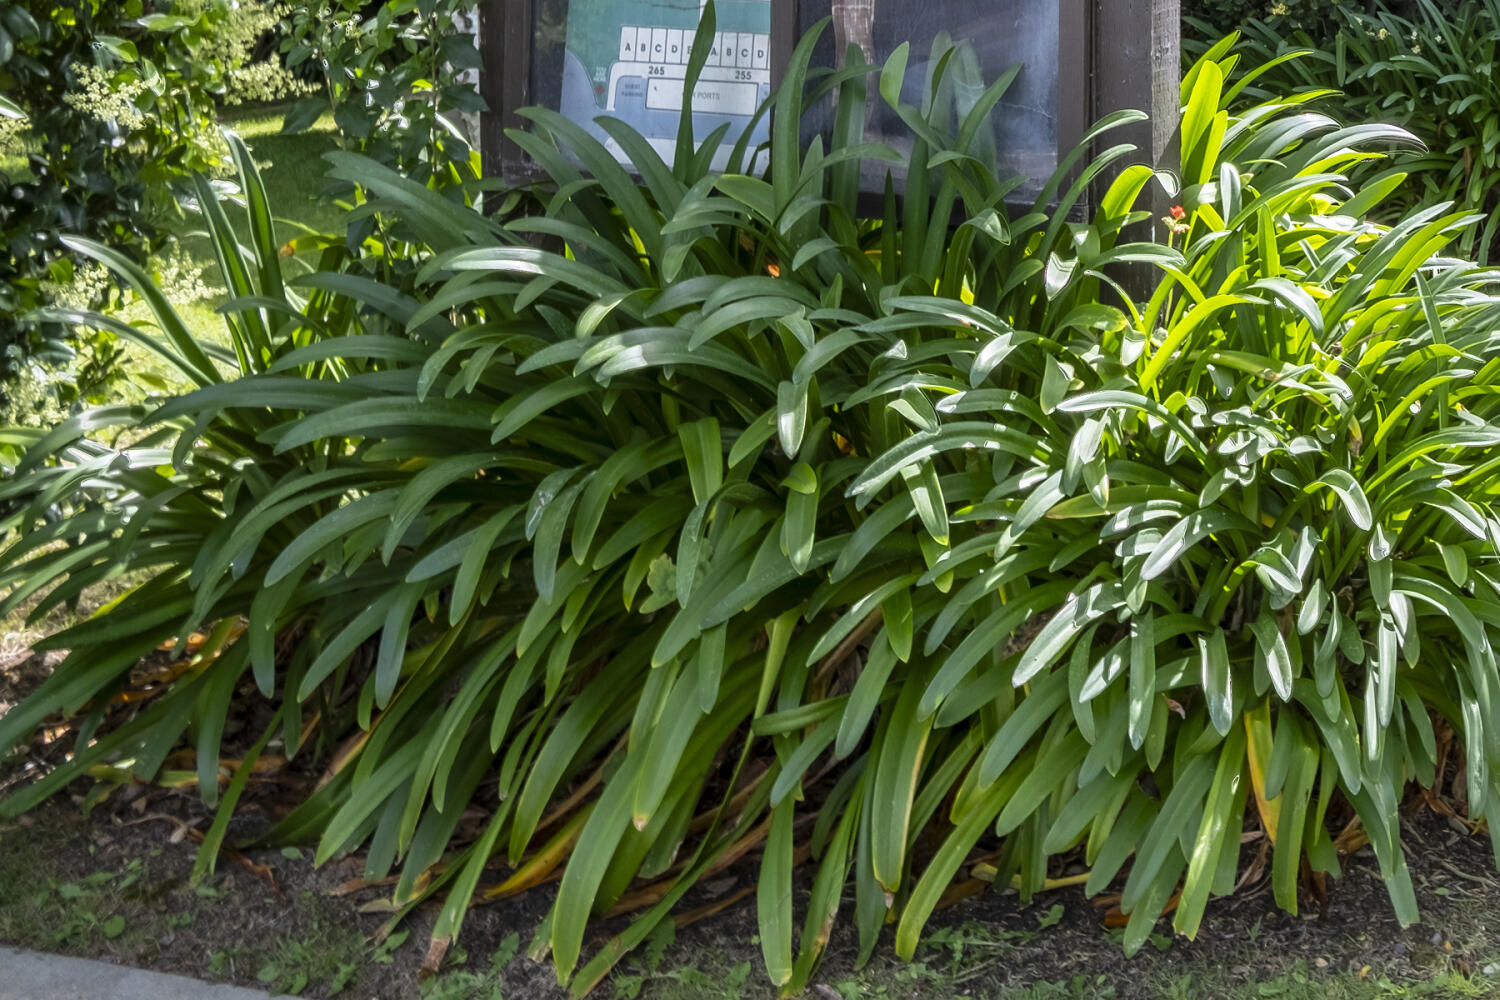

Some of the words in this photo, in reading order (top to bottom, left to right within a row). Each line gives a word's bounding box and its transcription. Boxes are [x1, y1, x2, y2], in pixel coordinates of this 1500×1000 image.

[625, 43, 631, 51] A
[640, 43, 646, 52] B
[655, 44, 662, 53] C
[671, 45, 678, 53] D
[711, 47, 717, 55] A
[726, 48, 732, 56] B
[741, 49, 748, 57] C
[648, 66, 665, 75] 265
[735, 71, 752, 80] 255
[698, 92, 720, 100] PORTS
